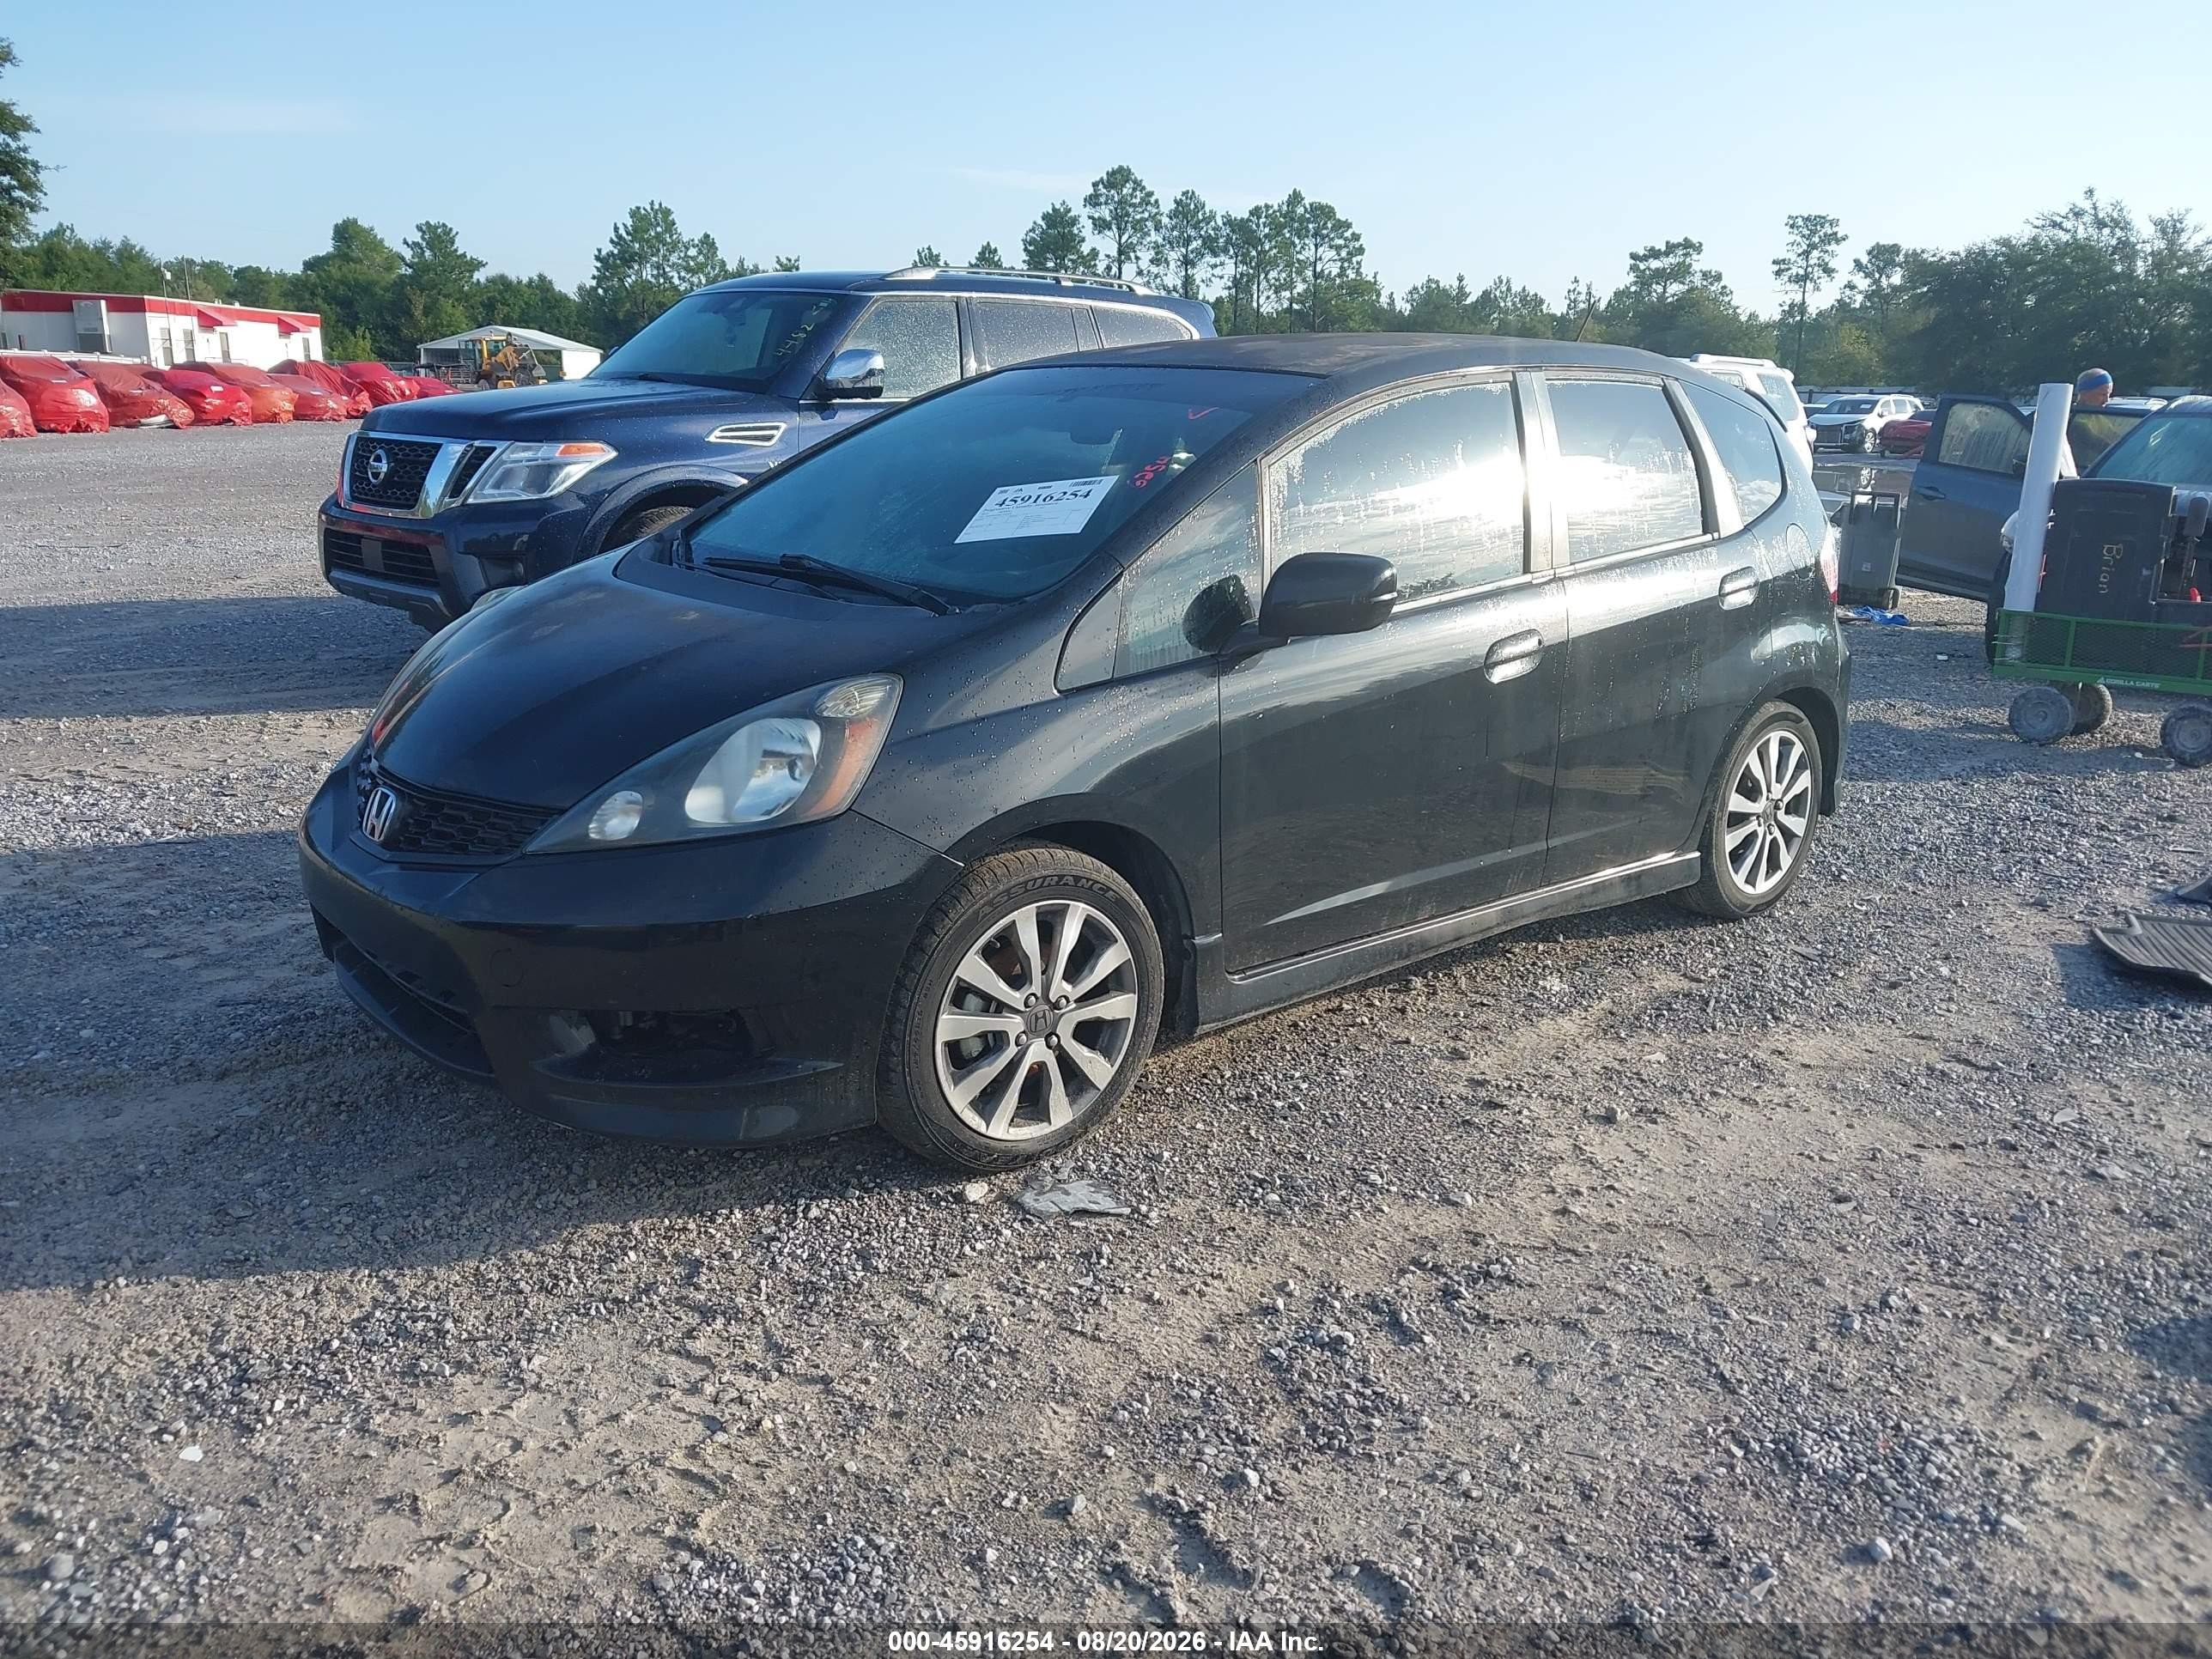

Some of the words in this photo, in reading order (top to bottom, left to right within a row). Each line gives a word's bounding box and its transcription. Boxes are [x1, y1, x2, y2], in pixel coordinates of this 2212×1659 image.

[994, 488, 1094, 508] 45916254
[2099, 543, 2124, 594] Brian
[977, 875, 1120, 922] ASSURANCE
